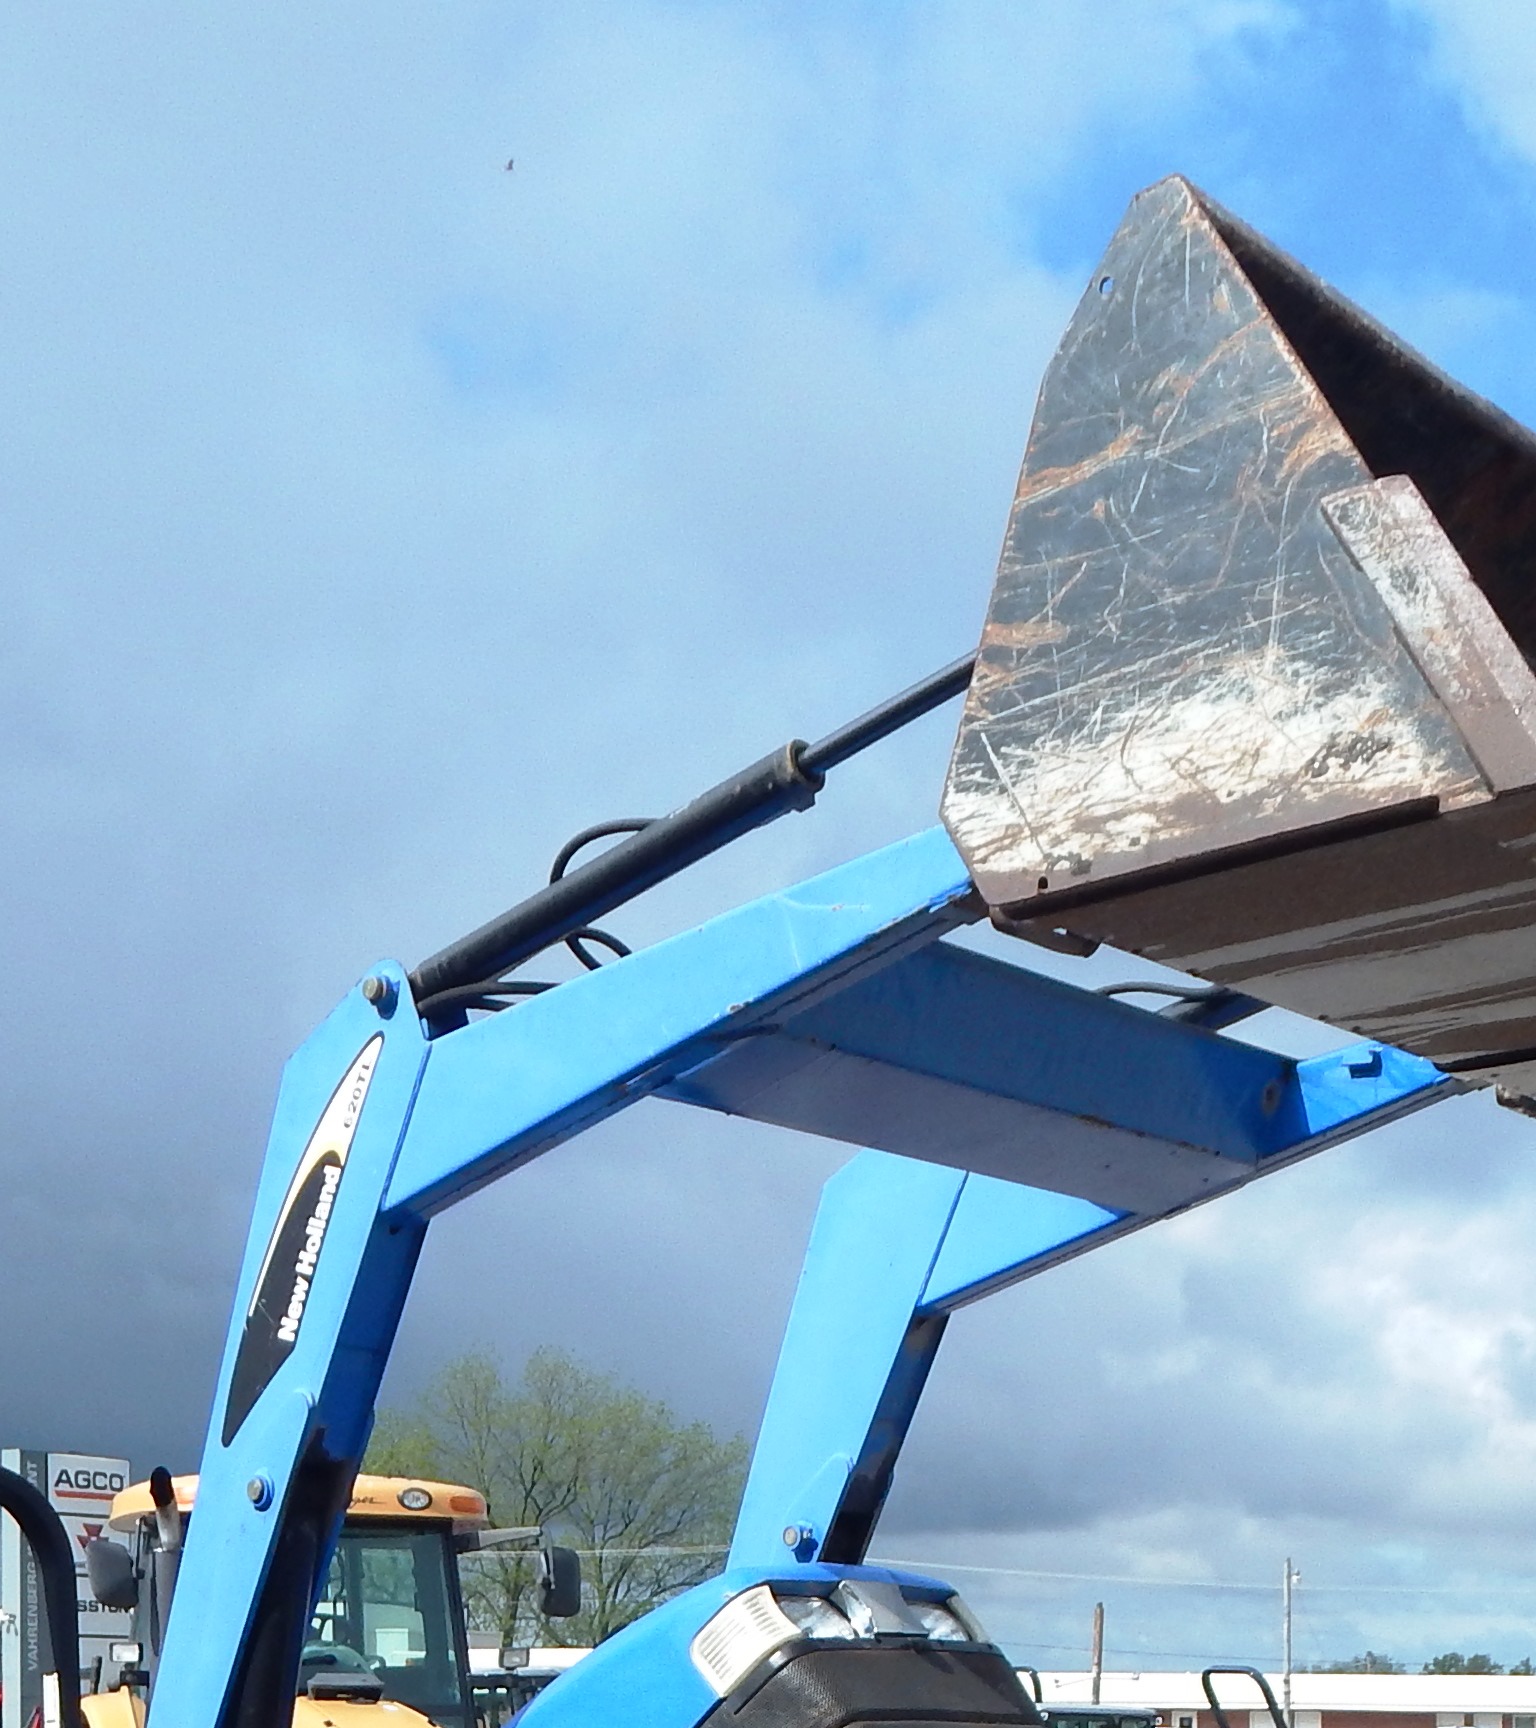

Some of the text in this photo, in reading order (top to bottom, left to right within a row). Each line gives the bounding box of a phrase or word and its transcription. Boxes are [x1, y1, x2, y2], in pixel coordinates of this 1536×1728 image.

[277, 1164, 343, 1342] New Holland
[54, 1469, 124, 1491] AGCO
[27, 1564, 40, 1672] VAHRENBERG
